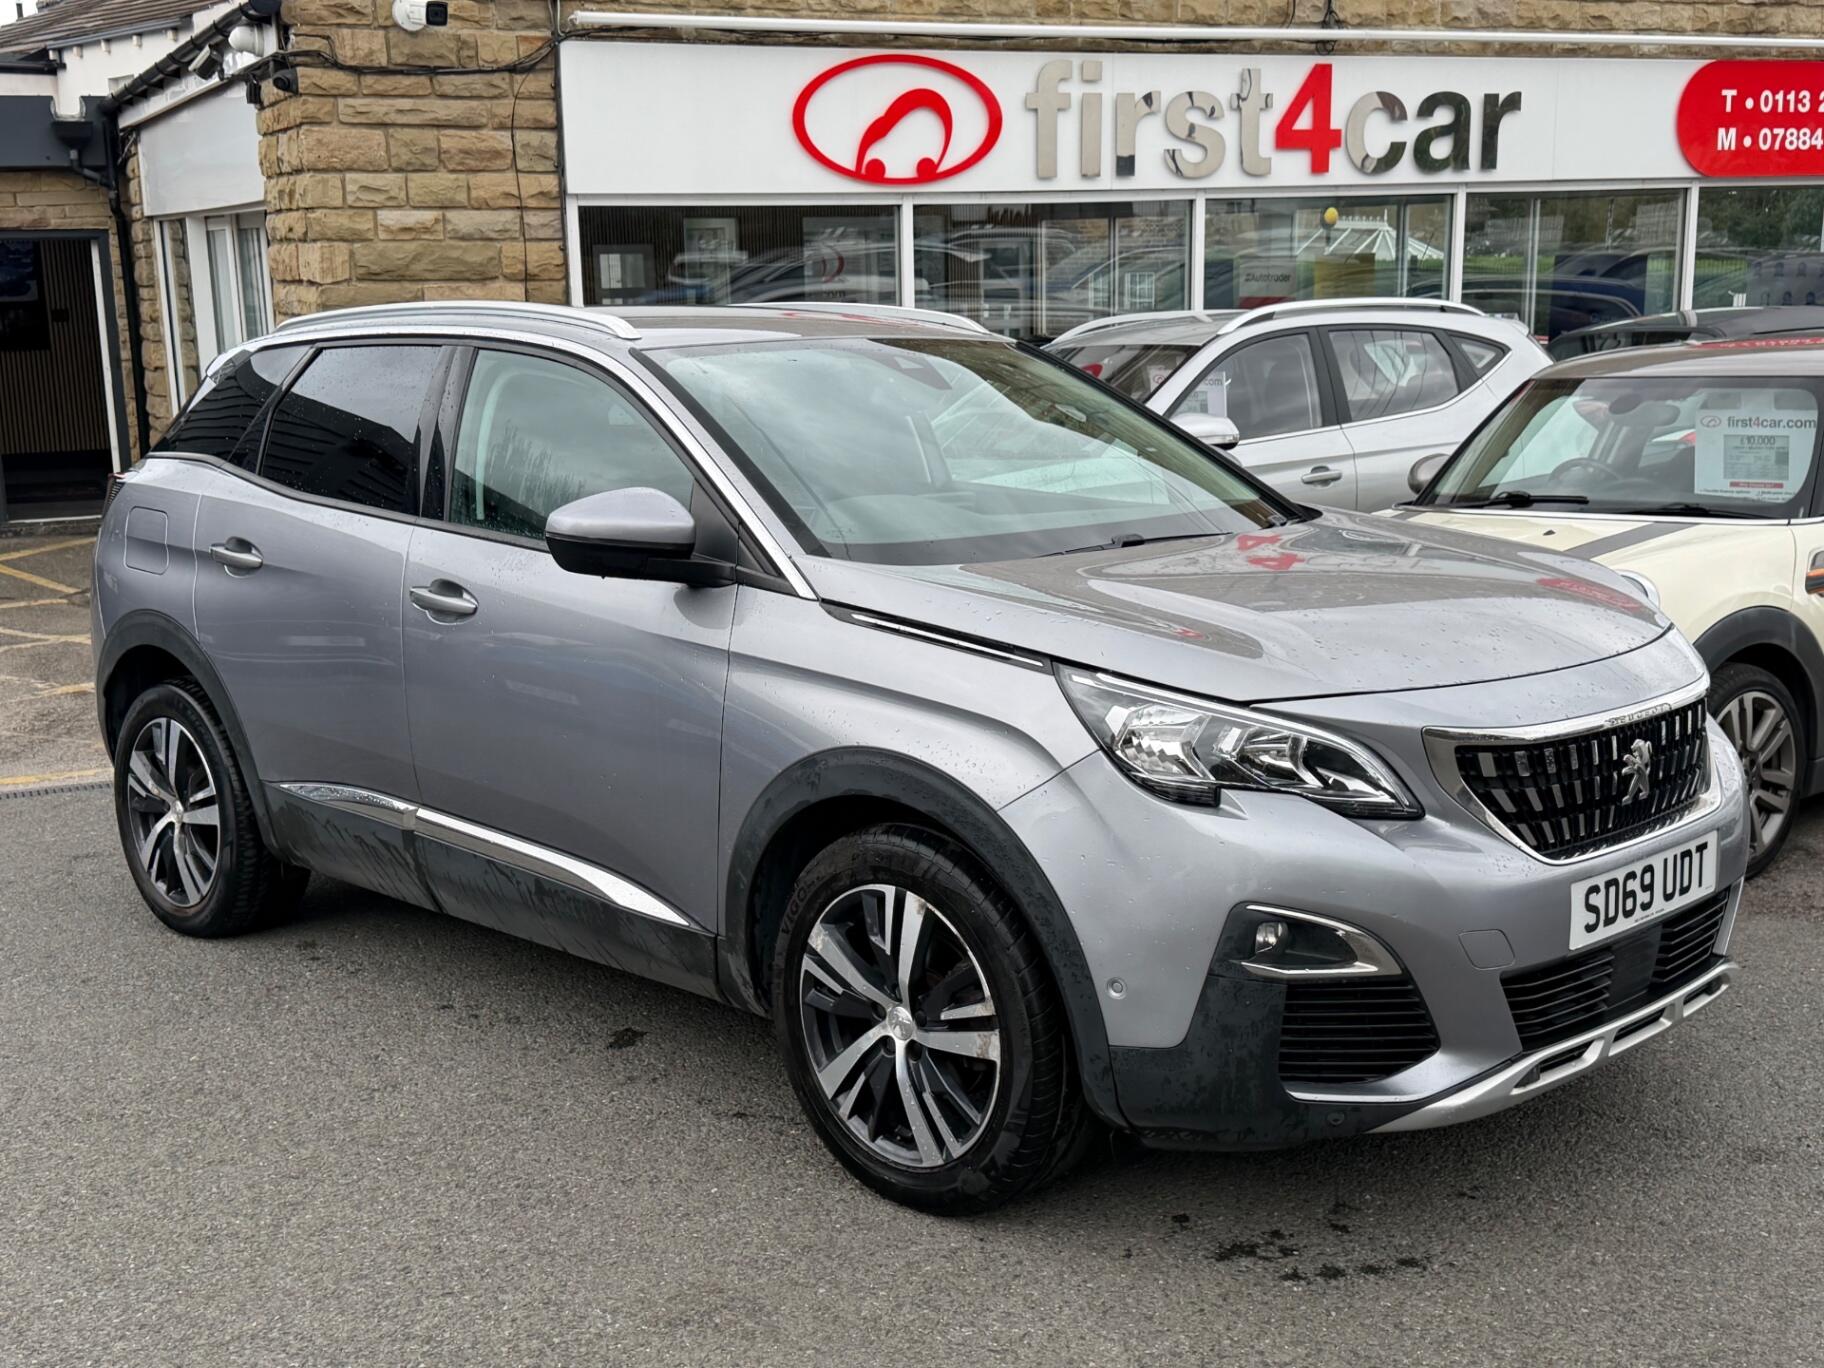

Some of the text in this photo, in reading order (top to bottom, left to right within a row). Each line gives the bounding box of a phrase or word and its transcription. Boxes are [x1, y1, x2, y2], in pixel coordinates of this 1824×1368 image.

[1721, 89, 1738, 112] T
[1760, 89, 1811, 113] 0113
[1025, 59, 1522, 180] first4car
[1716, 127, 1824, 151] M 07884
[1727, 416, 1817, 429] first4car.com
[1584, 842, 1708, 933] SD69 UDT
